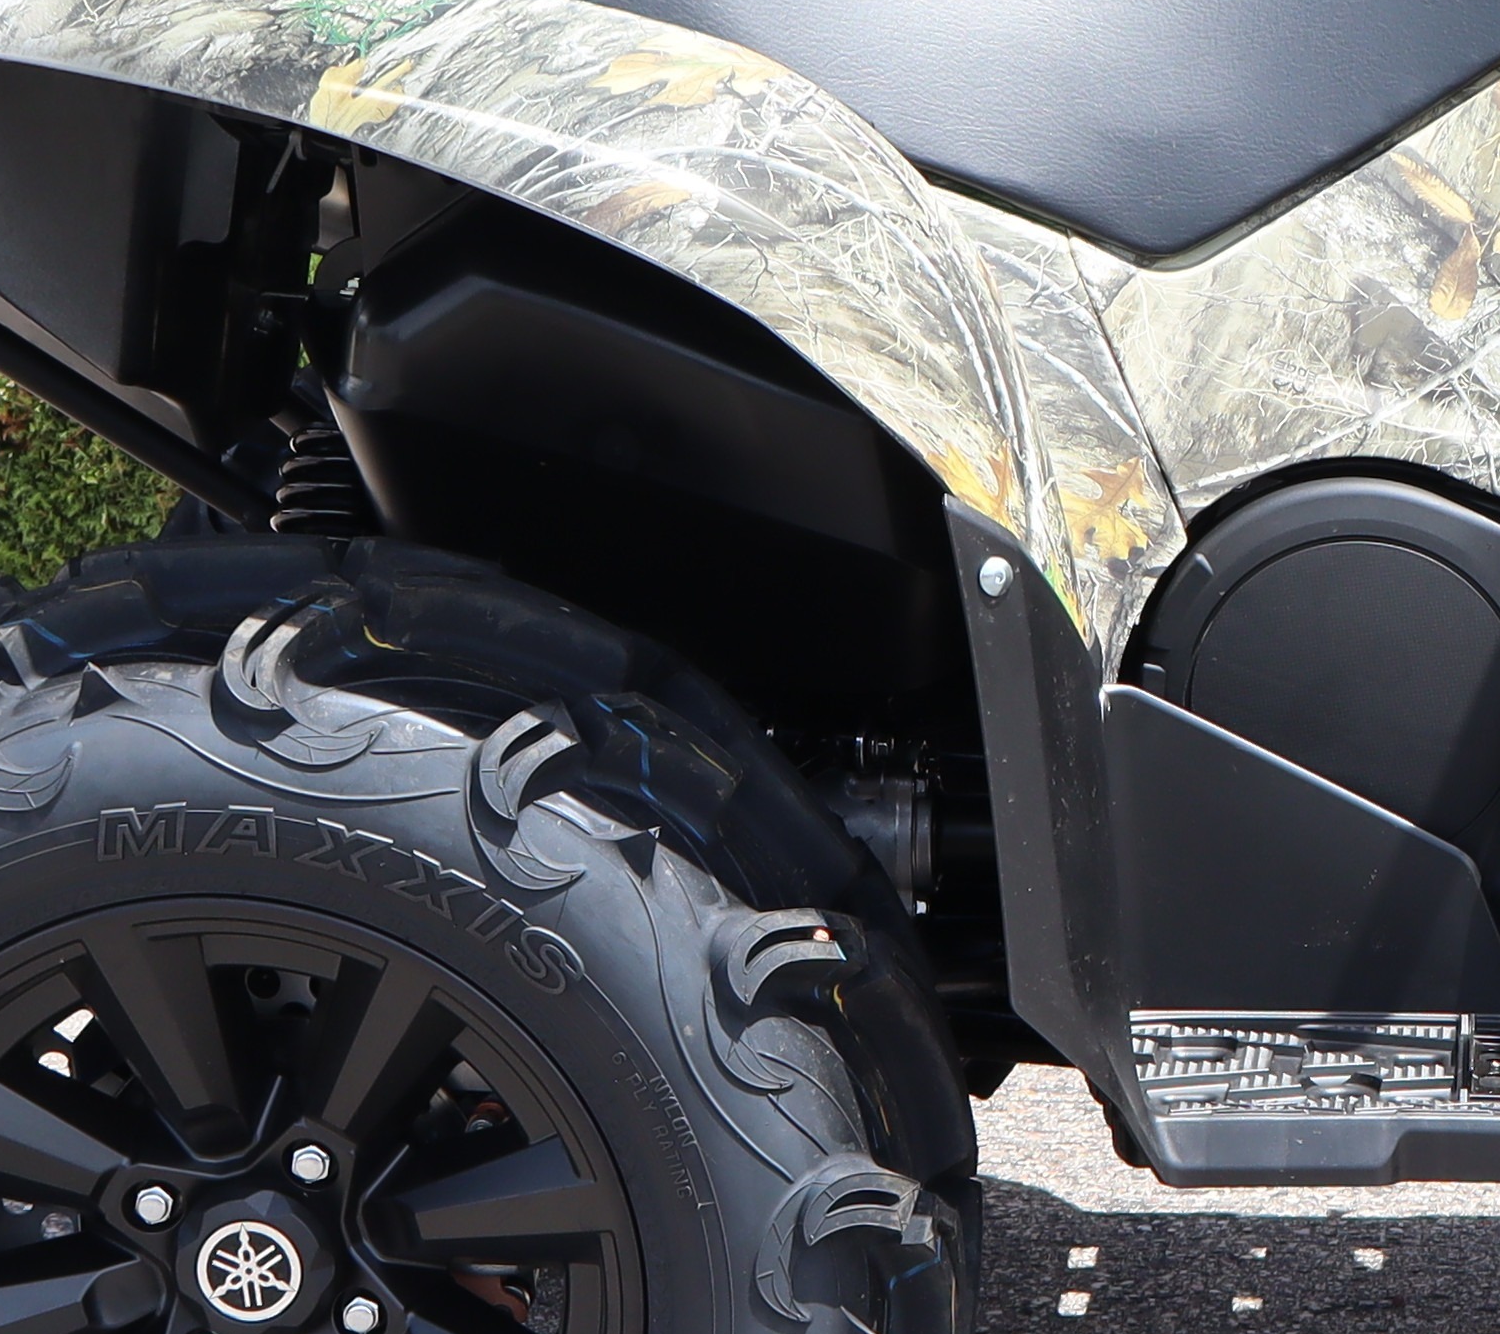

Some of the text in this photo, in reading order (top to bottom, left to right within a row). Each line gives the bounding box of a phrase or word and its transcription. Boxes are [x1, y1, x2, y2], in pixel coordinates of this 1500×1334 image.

[97, 801, 586, 996] MAXXIS
[609, 1048, 694, 1202] 6 PLY RATING
[647, 1069, 697, 1152] NYLON
